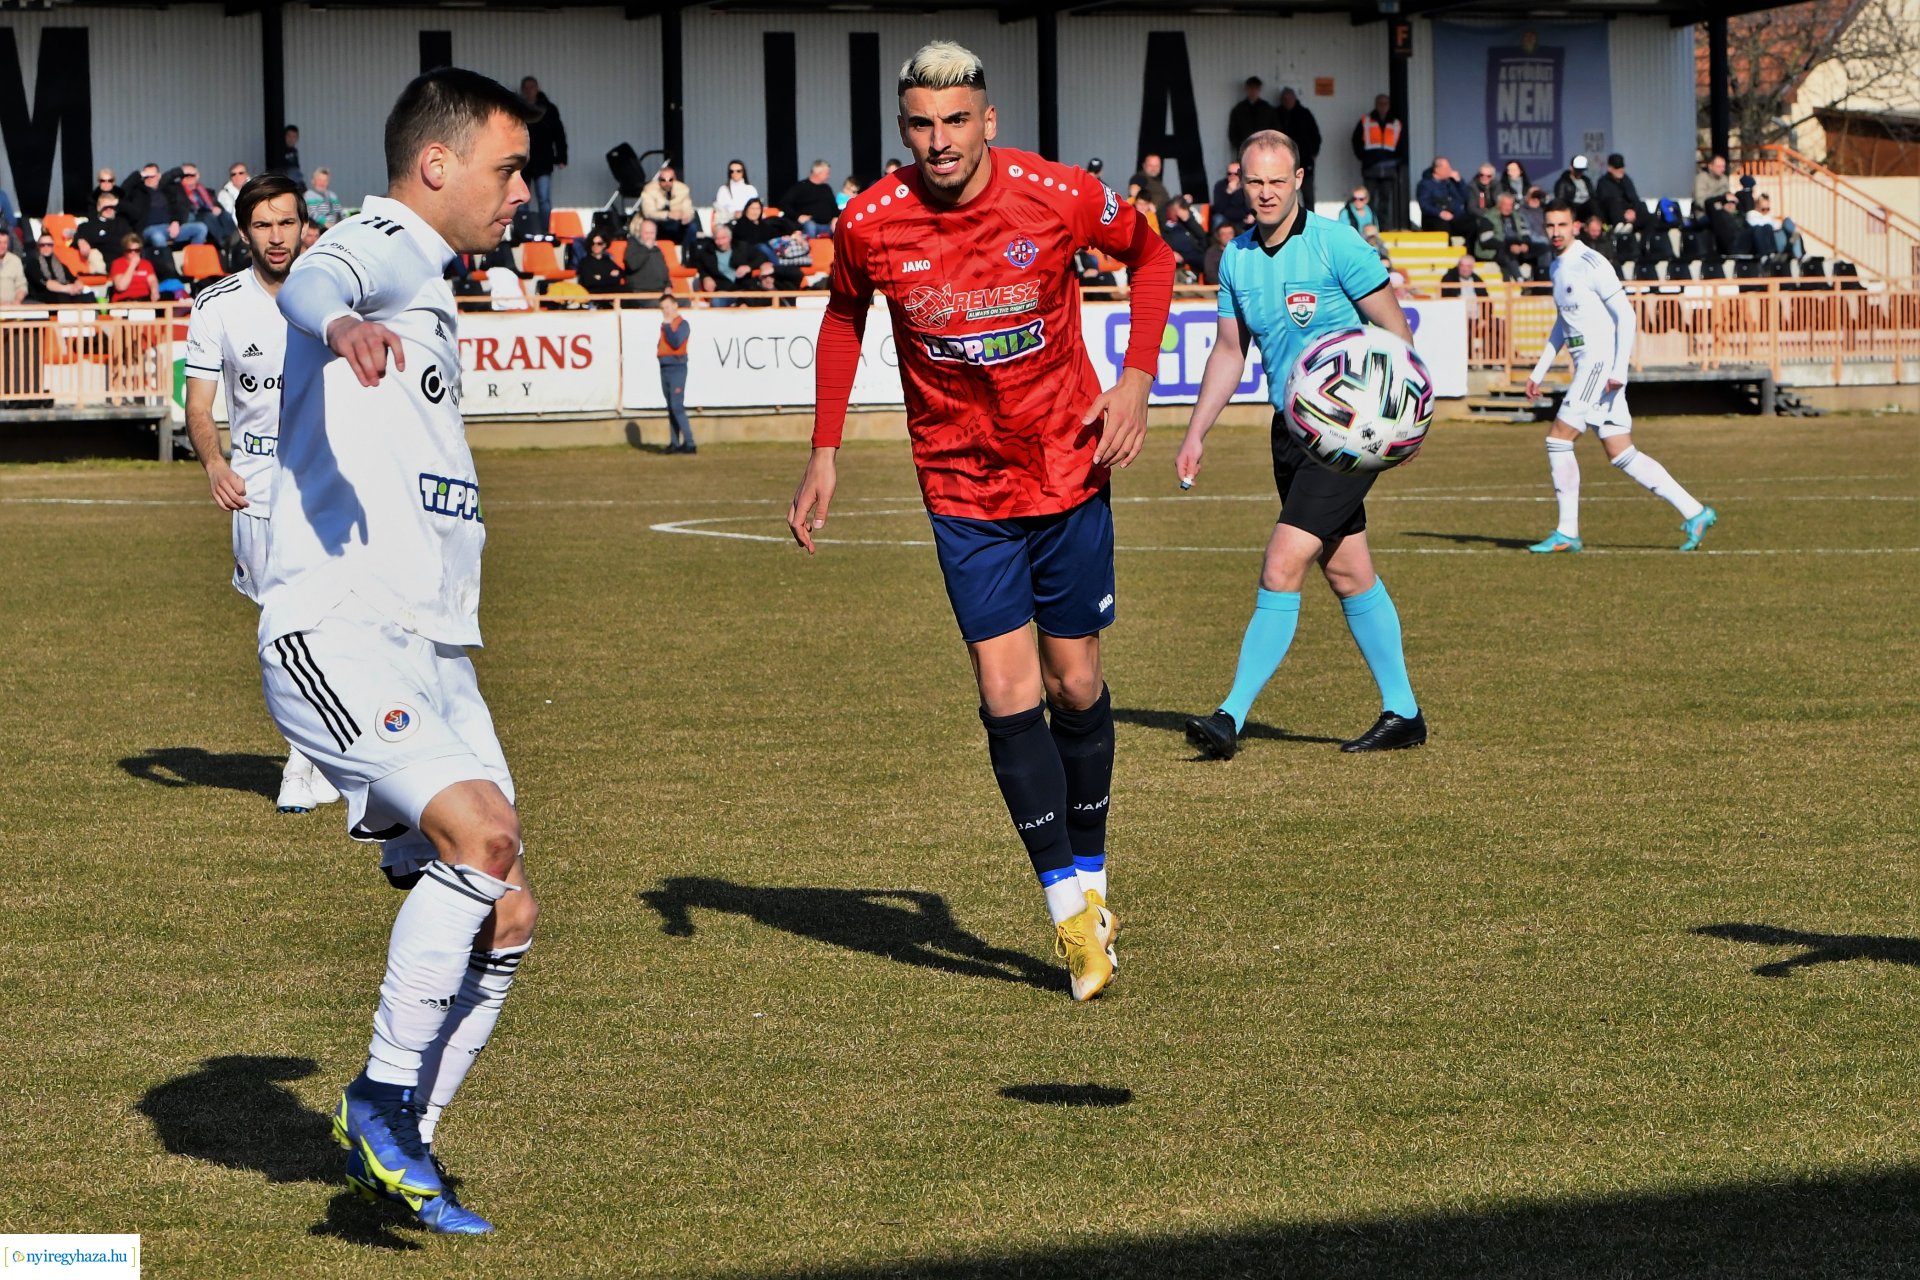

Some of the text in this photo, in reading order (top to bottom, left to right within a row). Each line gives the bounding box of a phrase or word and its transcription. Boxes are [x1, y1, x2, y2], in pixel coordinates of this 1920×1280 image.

[1397, 25, 1408, 46] F
[1497, 82, 1554, 122] NEM
[1497, 123, 1553, 154] PÁLYA!
[902, 260, 931, 273] JAKO
[968, 309, 990, 318] ALWAYS
[1010, 304, 1026, 312] RIGHT
[420, 475, 483, 520] TiPP
[1074, 796, 1108, 811] JAKO
[1018, 811, 1054, 830] JAKO
